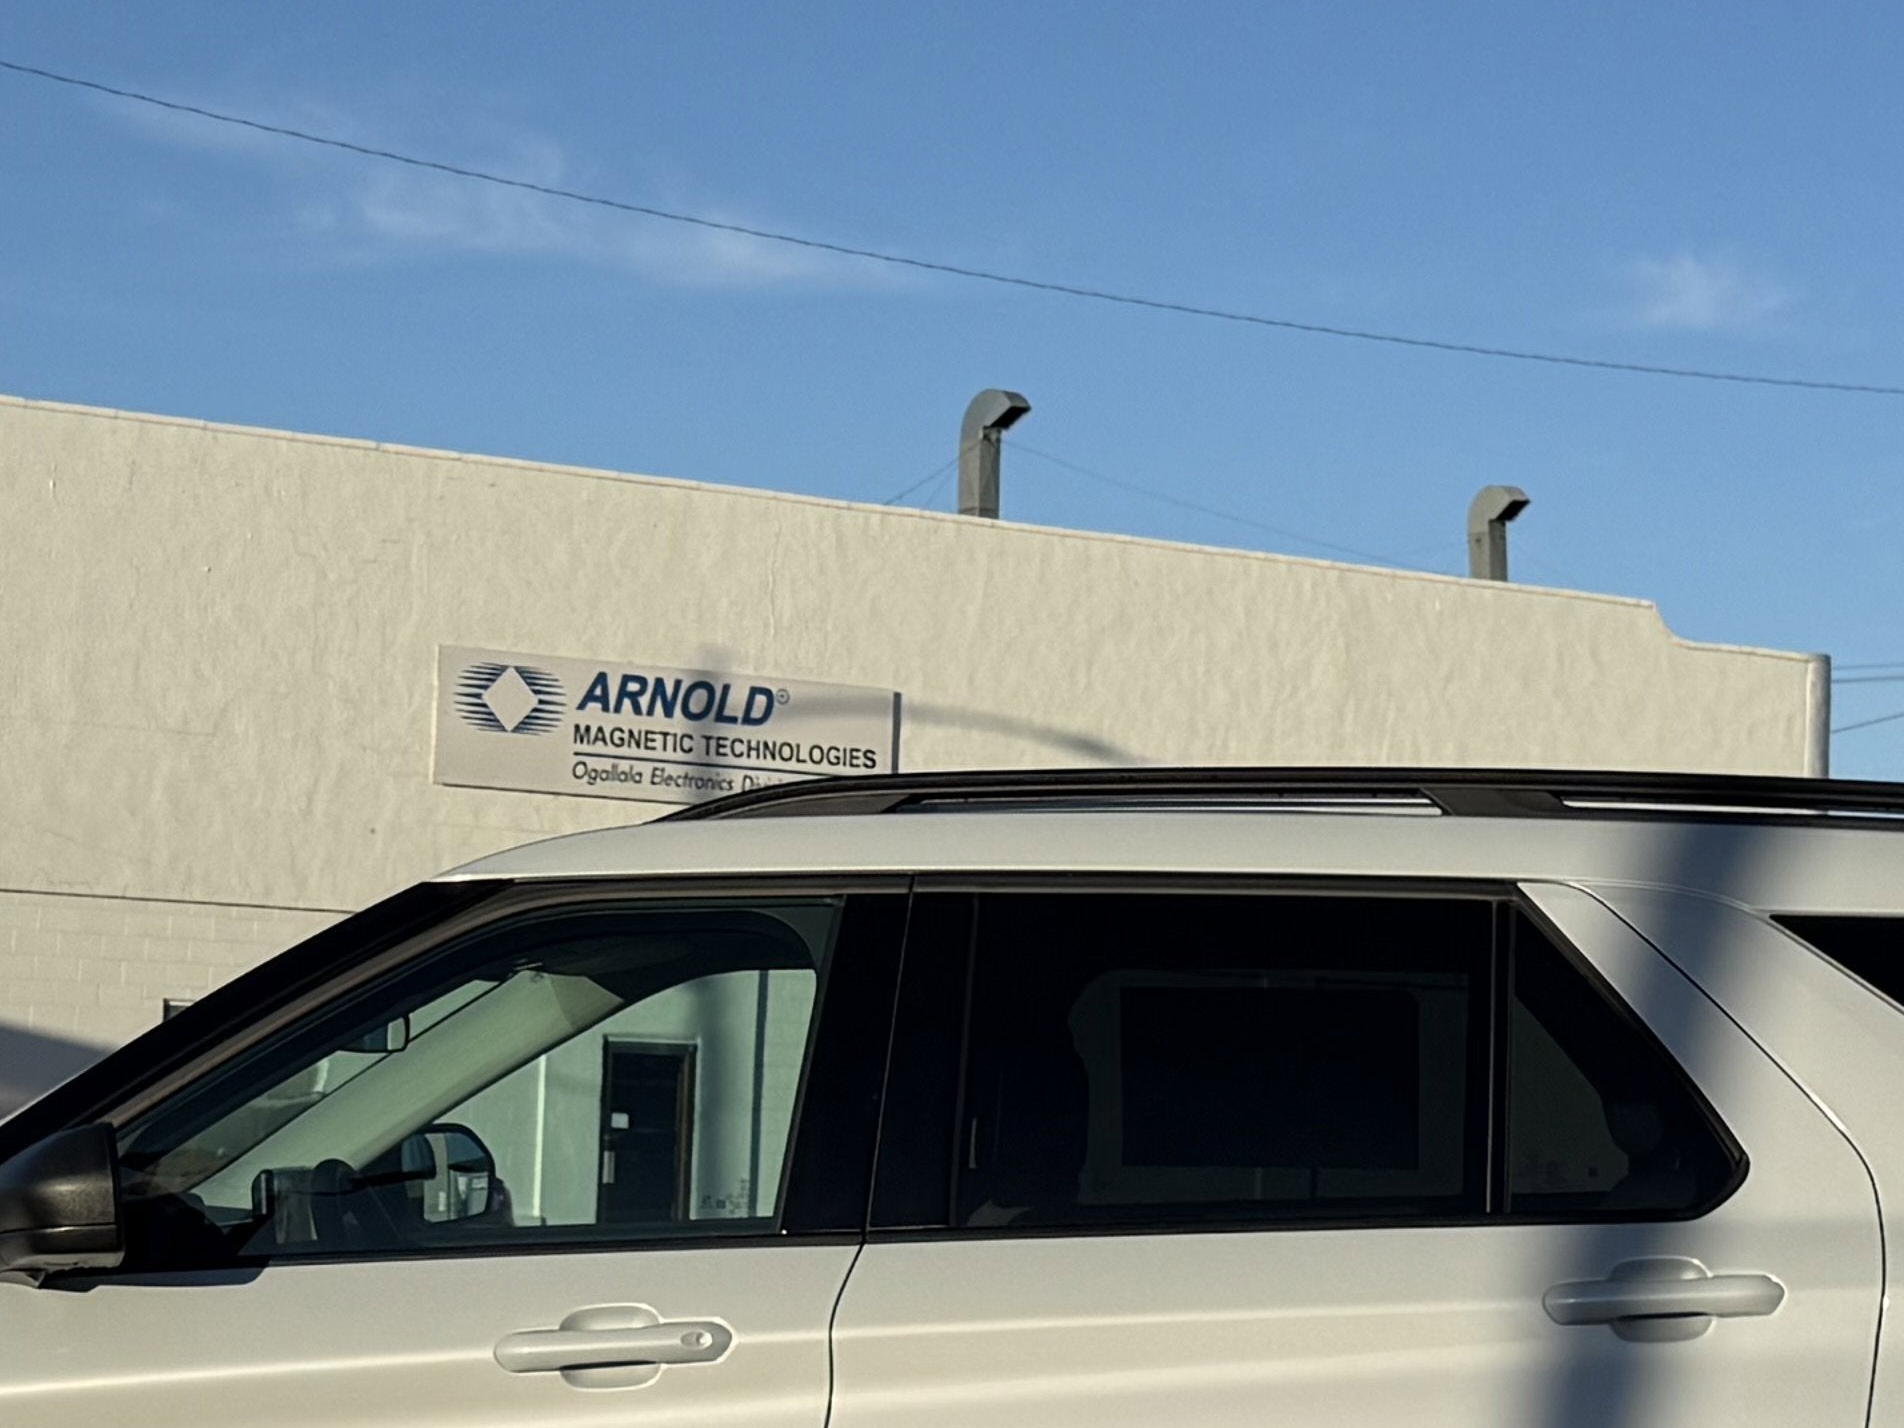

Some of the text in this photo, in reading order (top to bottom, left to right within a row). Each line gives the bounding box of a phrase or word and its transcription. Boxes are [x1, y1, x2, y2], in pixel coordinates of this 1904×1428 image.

[575, 671, 775, 727] ARNOLD
[573, 723, 878, 770] MAGNETIC TECHNOLOGIES
[572, 761, 643, 786] Ogallala
[650, 766, 734, 792] Electronics
